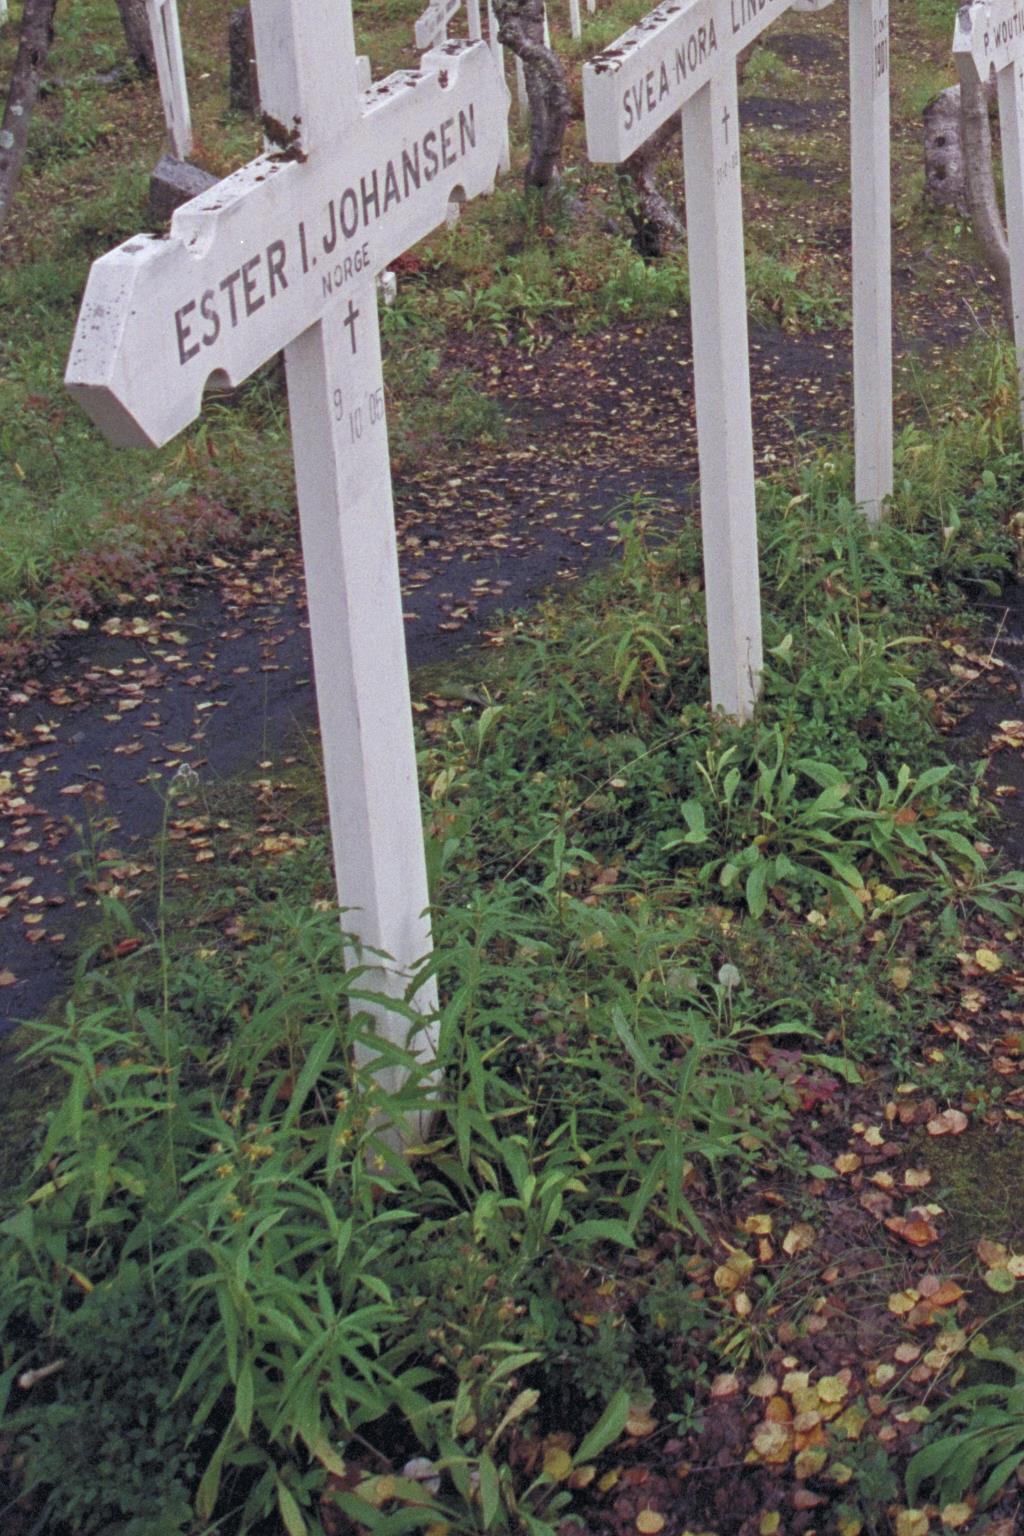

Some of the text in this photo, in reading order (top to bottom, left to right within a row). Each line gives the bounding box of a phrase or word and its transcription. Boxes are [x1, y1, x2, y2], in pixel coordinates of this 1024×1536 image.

[623, 60, 669, 130] SVEA
[674, 17, 718, 85] NORA
[174, 102, 477, 365] ESTER I. JOHANSEN
[321, 241, 370, 299] NORGE
